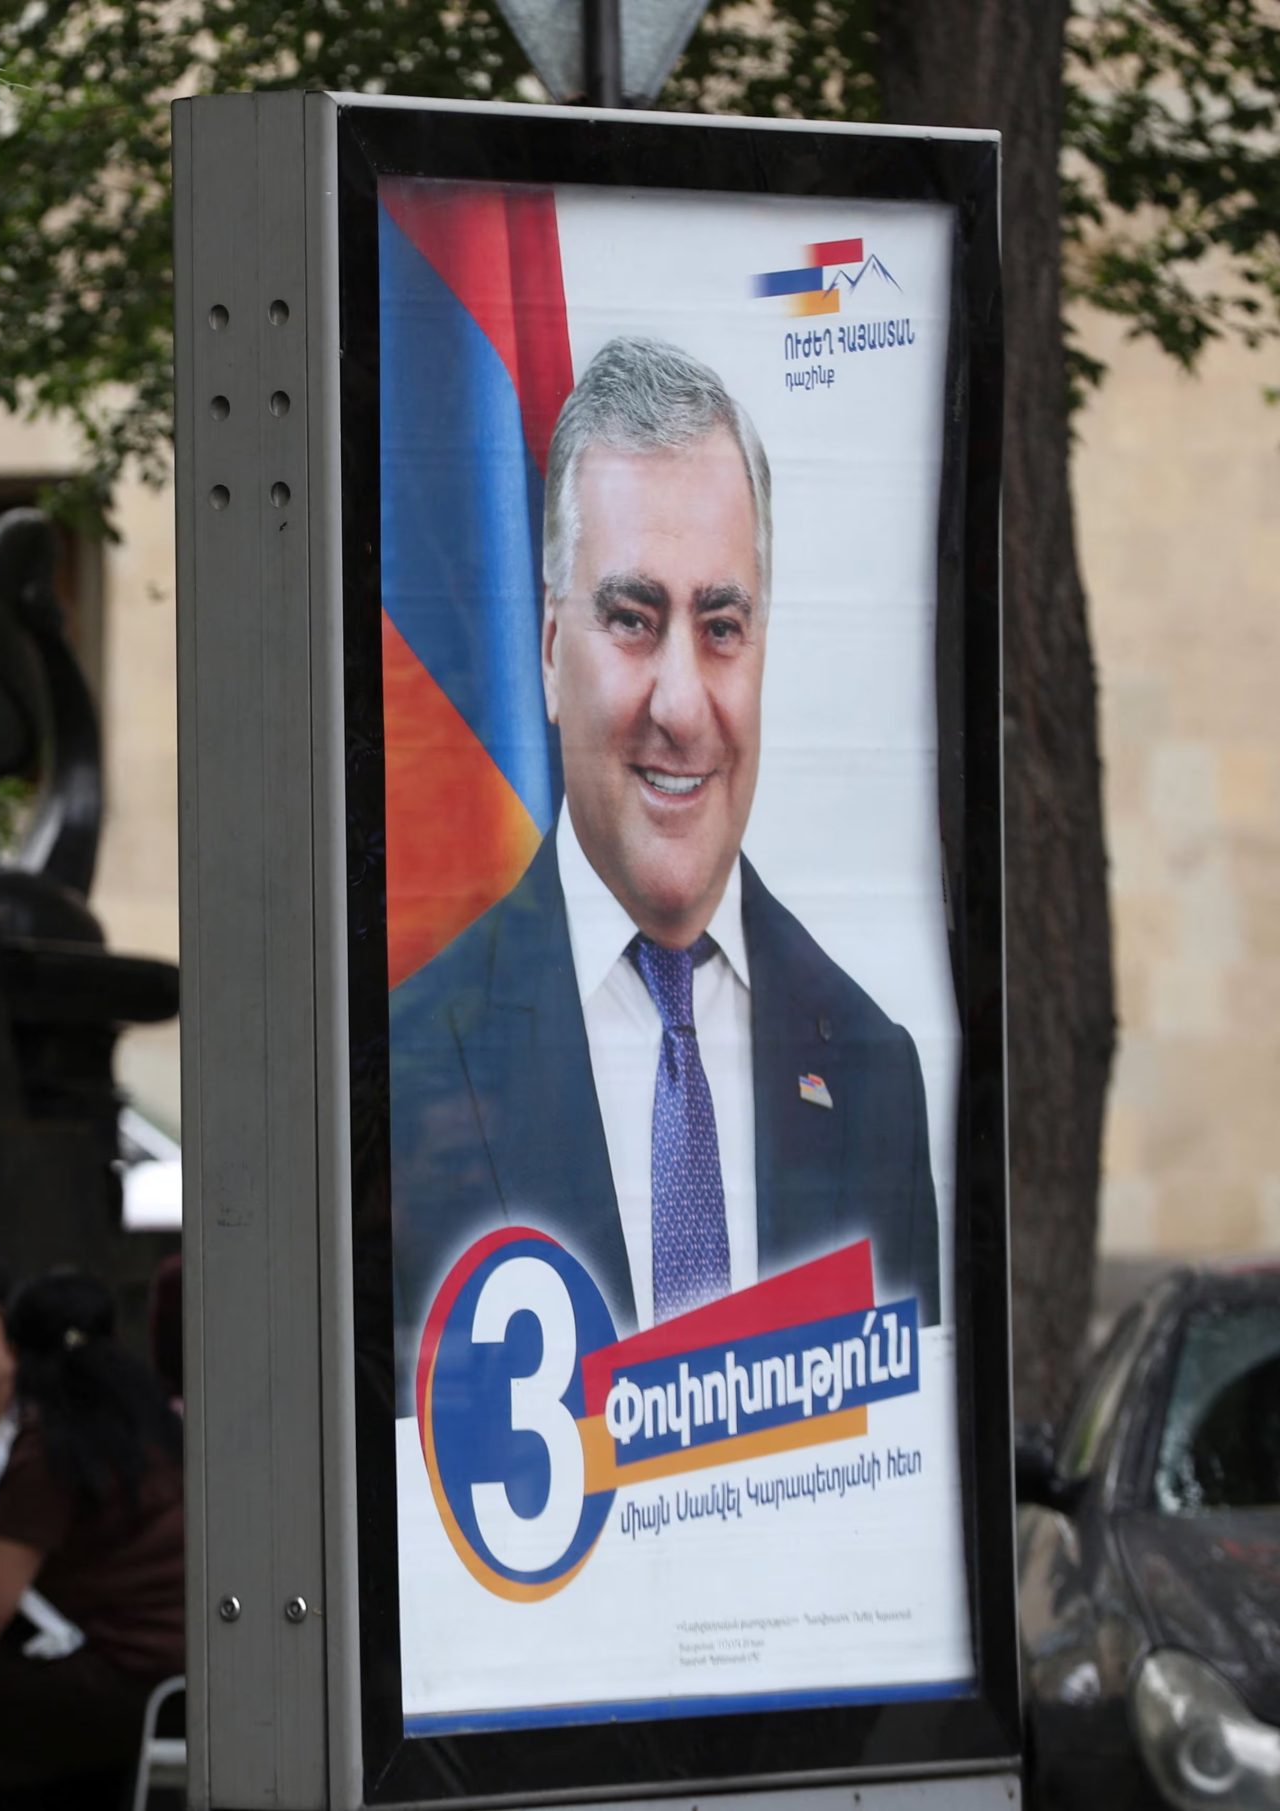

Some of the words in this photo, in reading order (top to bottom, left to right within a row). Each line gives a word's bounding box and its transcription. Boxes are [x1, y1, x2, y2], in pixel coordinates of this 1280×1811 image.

[838, 318, 915, 353] ՀԱՅԱՍՏԱՆ
[785, 365, 835, 391] դաշինք
[470, 1256, 585, 1572] 3
[621, 1494, 670, 1541] միայն
[676, 1481, 742, 1521] Սամվել
[746, 1451, 881, 1511] Կարապետյանի
[887, 1446, 922, 1479] հետ
